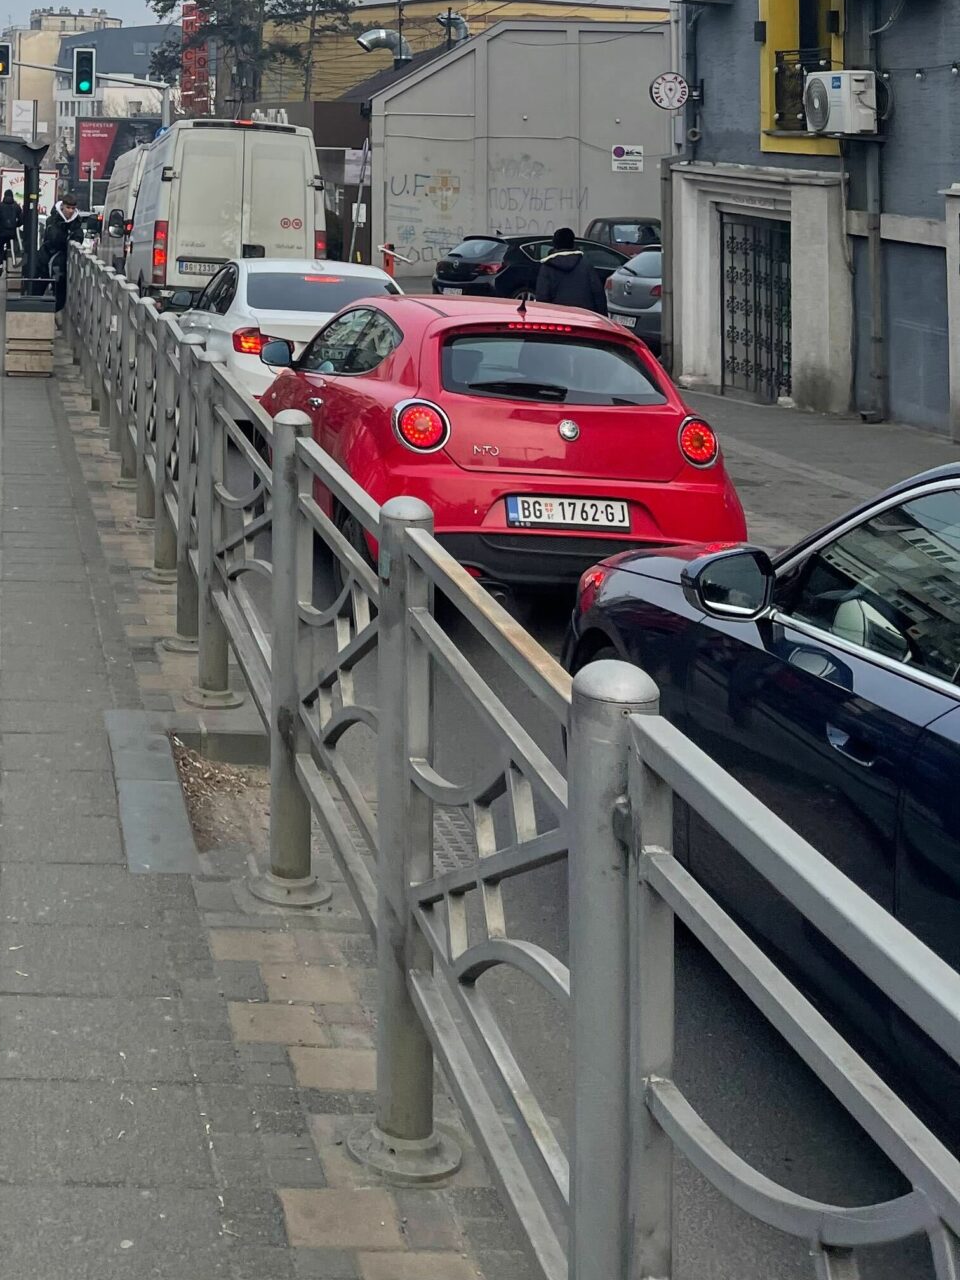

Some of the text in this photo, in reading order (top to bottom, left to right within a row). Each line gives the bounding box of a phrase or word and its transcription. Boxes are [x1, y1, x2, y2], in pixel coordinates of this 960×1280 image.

[654, 76, 687, 104] STELLA ARTOIS
[521, 499, 542, 519] BG
